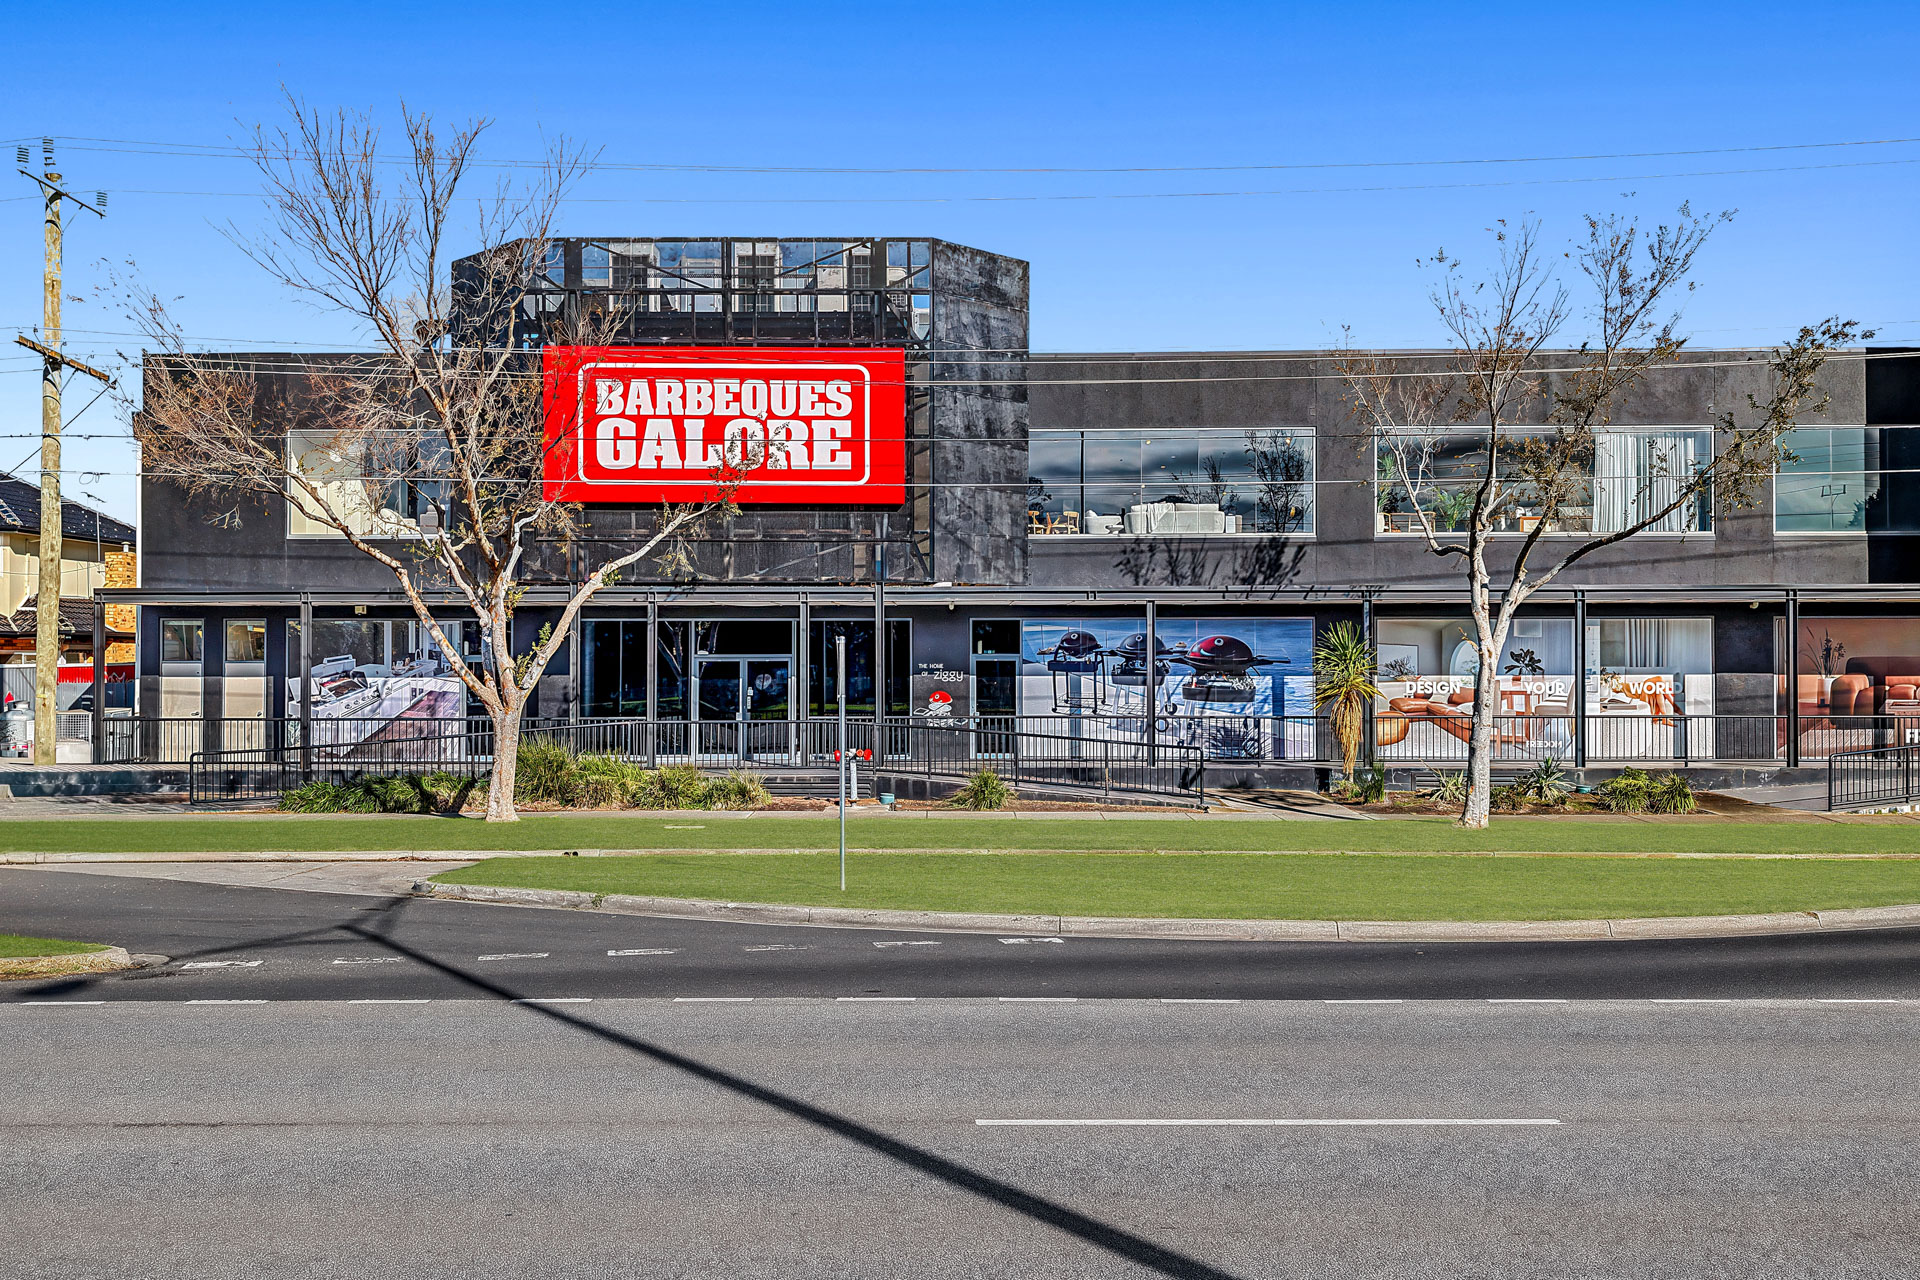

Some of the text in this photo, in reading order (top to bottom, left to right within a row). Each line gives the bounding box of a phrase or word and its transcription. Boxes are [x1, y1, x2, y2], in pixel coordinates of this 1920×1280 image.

[595, 379, 853, 420] BARBEQUES
[596, 417, 852, 471] GALORE
[934, 669, 963, 682] ziggy
[1405, 681, 1683, 695] DESIGN YOUR WORLD
[1525, 740, 1563, 748] FREEDOM
